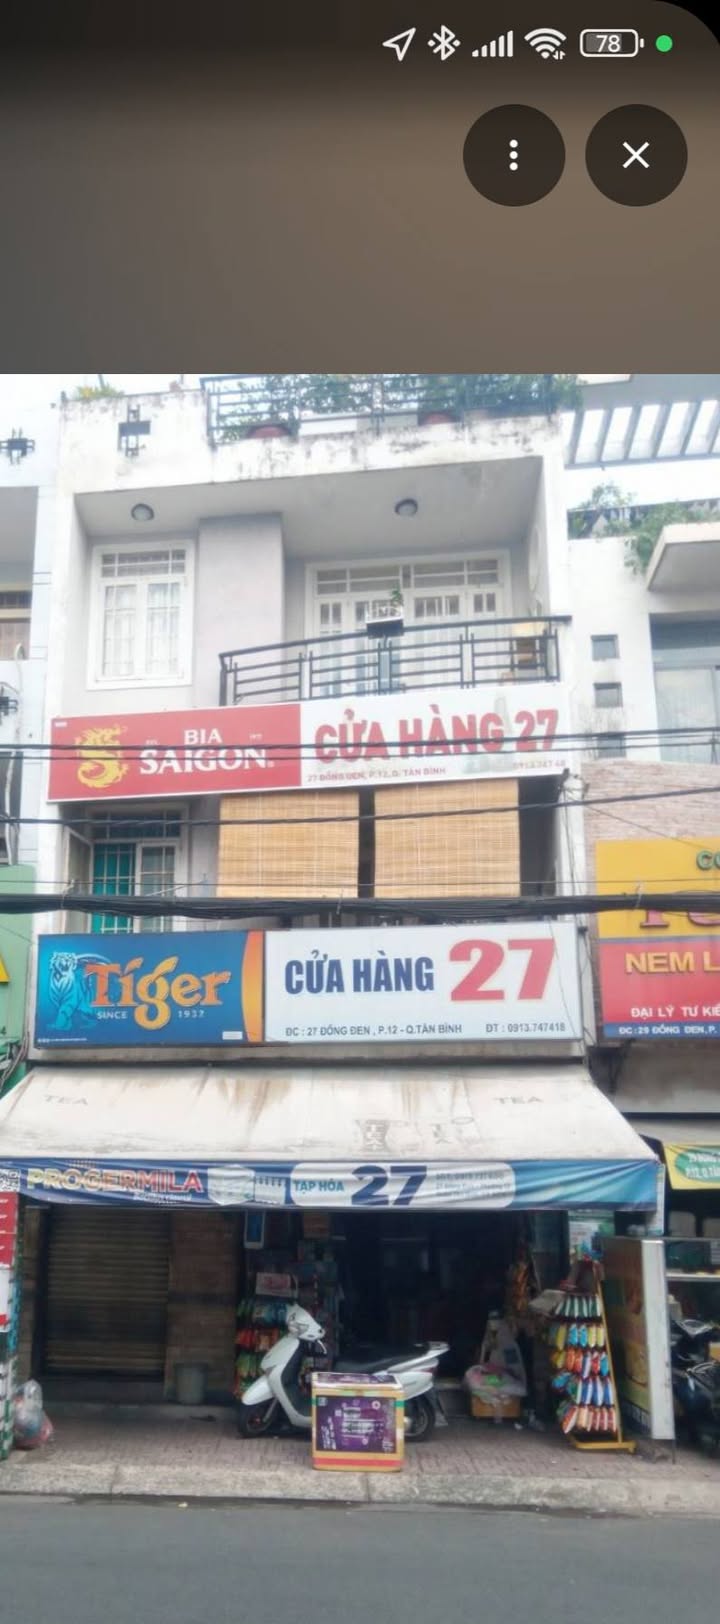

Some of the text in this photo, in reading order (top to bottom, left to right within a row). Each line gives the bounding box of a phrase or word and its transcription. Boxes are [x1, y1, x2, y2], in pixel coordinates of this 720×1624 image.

[184, 728, 223, 746] BIA
[314, 703, 559, 764] CỬA HÀNG 27
[139, 747, 267, 775] SAIGON
[284, 937, 556, 1002] CỬA HÀNG 27
[625, 951, 696, 974] NEM
[83, 955, 232, 1031] Tiger
[97, 1010, 128, 1020] SINCE
[630, 1006, 654, 1020] ĐẠI
[681, 1004, 700, 1018] TƯ
[307, 1026, 318, 1037] 27
[26, 1167, 204, 1194] PROGERMILA
[293, 1179, 319, 1194] TẠP
[320, 1177, 345, 1192] HÓA
[350, 1164, 428, 1206] 27
